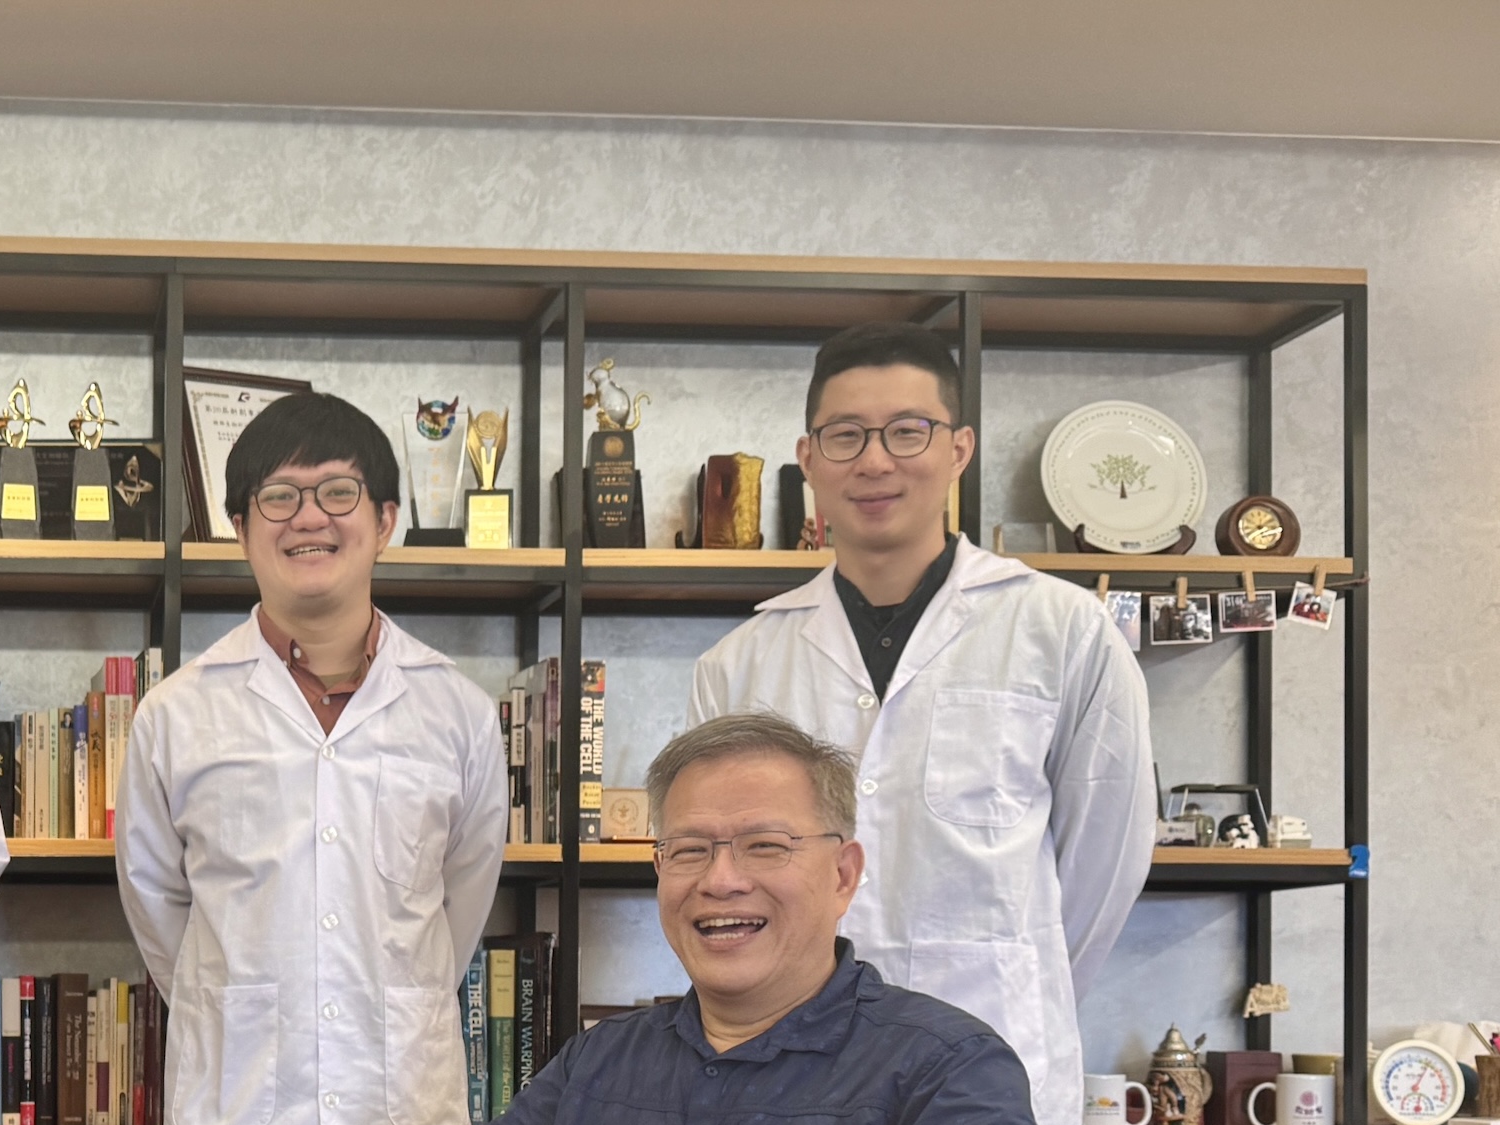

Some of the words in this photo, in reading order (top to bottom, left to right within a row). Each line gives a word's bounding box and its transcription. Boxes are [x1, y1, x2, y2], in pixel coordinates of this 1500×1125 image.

[593, 698, 605, 723] THE
[581, 716, 593, 741] THE
[580, 743, 593, 774] CELL
[592, 725, 604, 775] WORLD
[521, 979, 533, 1022] BRAIN
